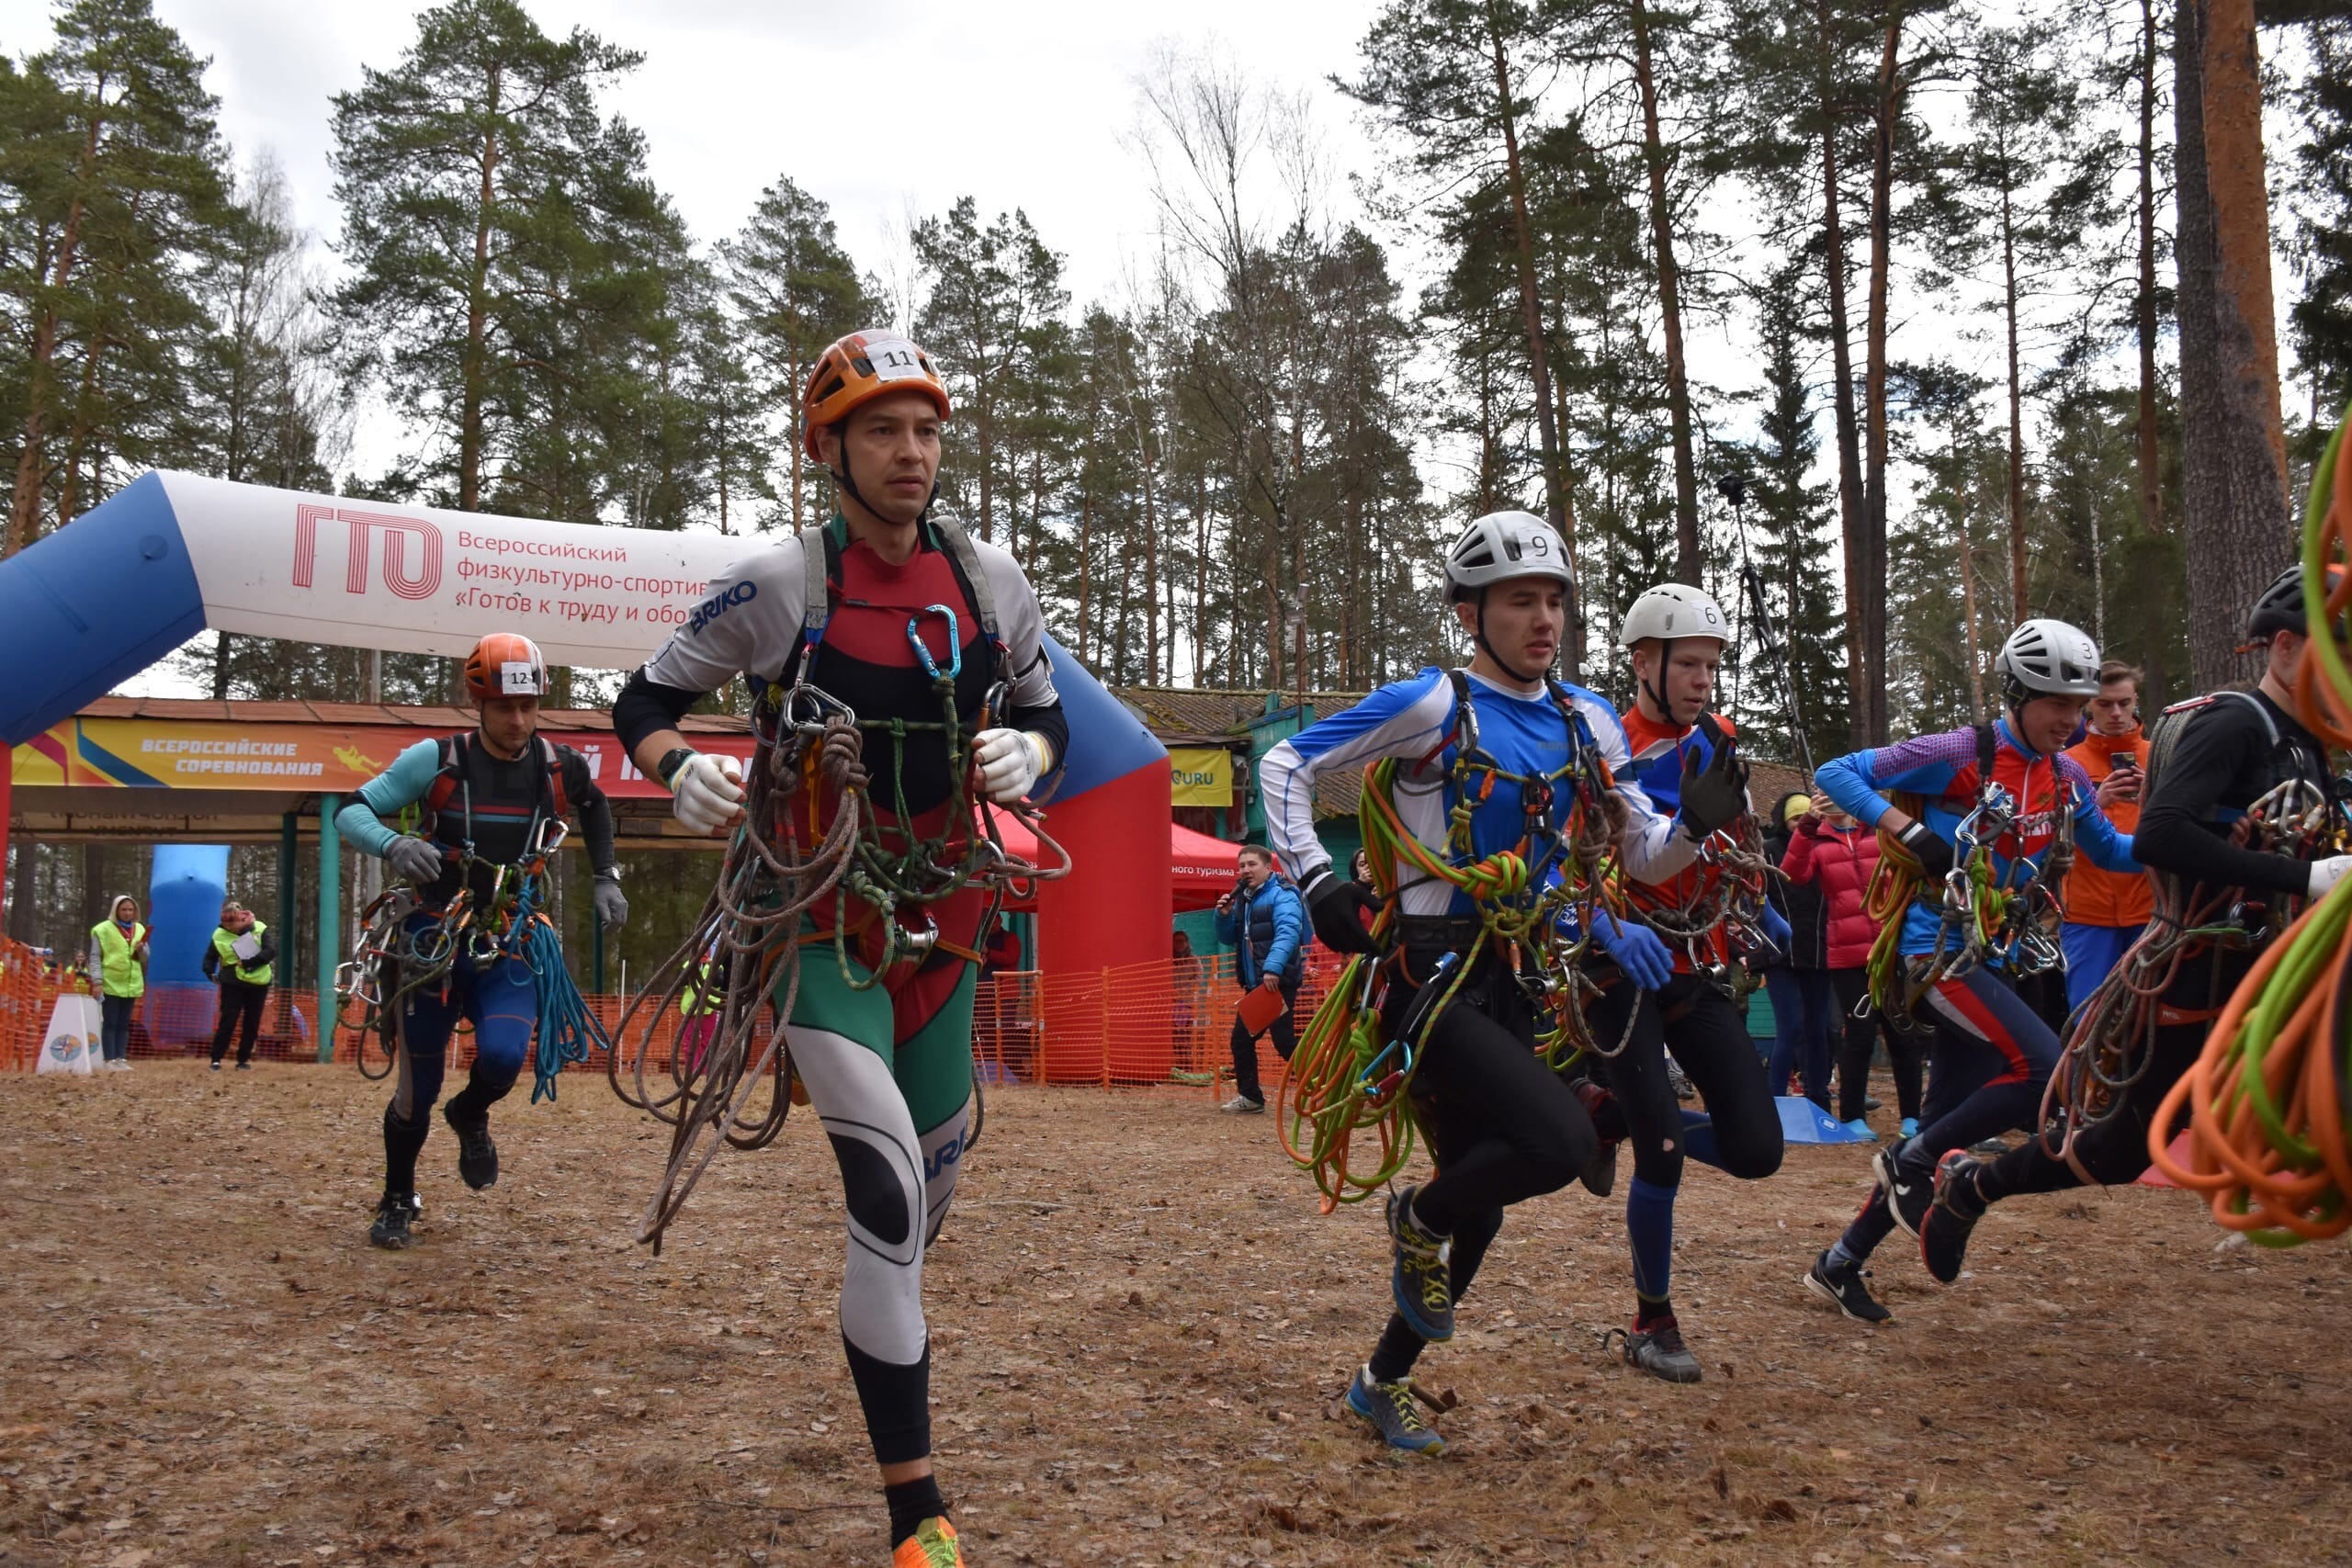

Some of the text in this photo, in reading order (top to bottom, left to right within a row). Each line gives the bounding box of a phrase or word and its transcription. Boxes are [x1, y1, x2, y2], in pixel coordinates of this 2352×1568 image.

[884, 350, 914, 368] 11
[292, 503, 443, 600] ГТО
[458, 530, 627, 562] Всероссийский
[1532, 536, 1548, 558] 9
[455, 587, 532, 613] «Готов
[539, 599, 551, 615] к
[558, 600, 619, 625] труду
[626, 606, 639, 621] и
[689, 580, 758, 637] BRIKO
[1704, 606, 1717, 625] 6
[2081, 642, 2093, 660] 3
[510, 671, 528, 684] 12
[141, 738, 298, 757] ВСЕРОССИЙСКИЕ
[175, 759, 324, 776] СОРЕВНОВАНИЯ
[1195, 866, 1235, 878] туризма
